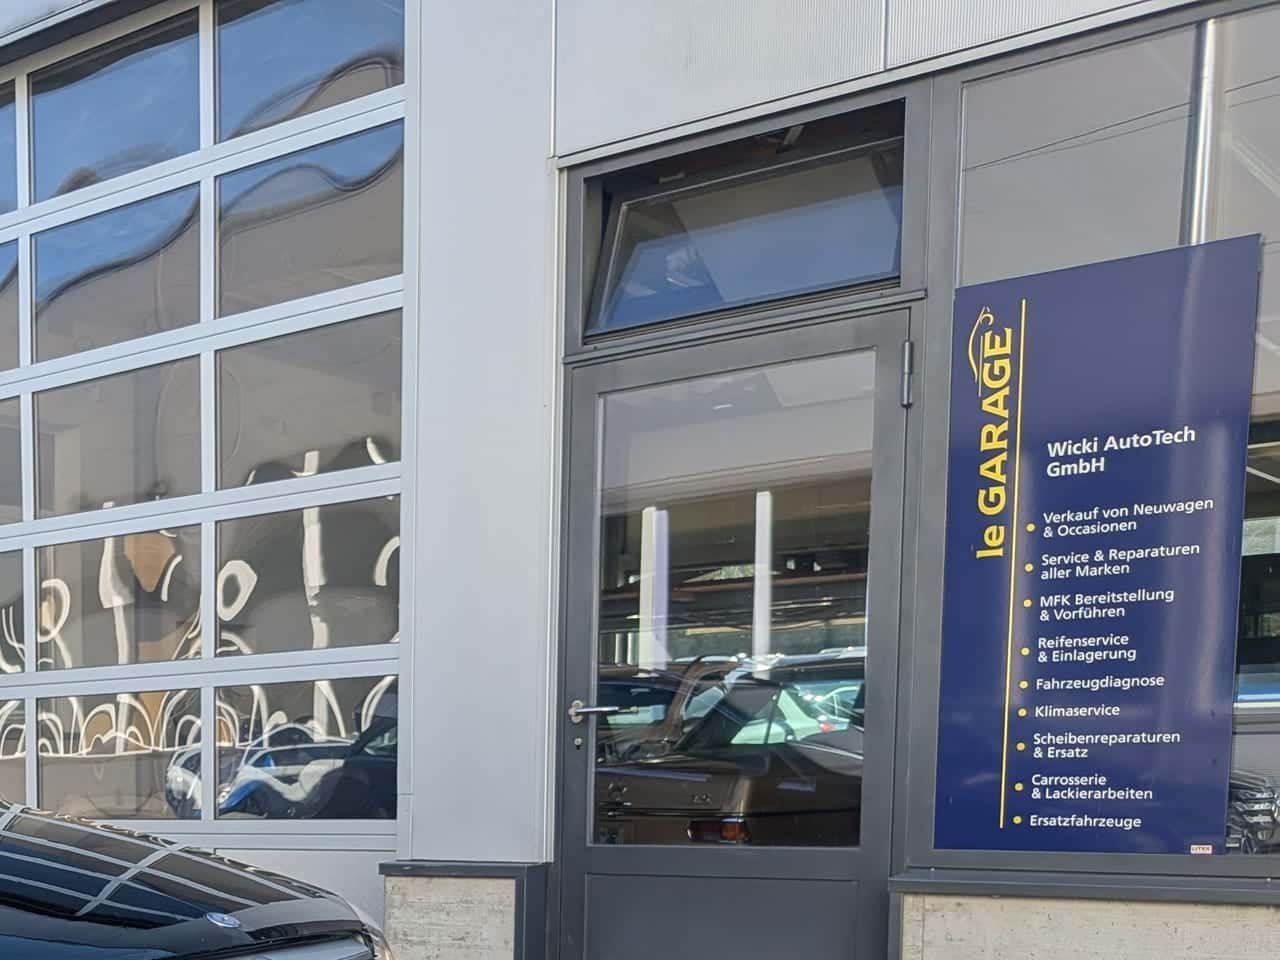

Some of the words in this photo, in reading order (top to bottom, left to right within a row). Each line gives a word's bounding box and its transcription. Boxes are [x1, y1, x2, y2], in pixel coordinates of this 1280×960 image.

[978, 328, 1012, 516] GARAGE
[1047, 437, 1099, 458] Wicki
[1104, 425, 1196, 451] AutoTech
[1046, 457, 1105, 477] GmbH
[1043, 507, 1099, 524] Verkauf
[1102, 506, 1129, 518] von
[1133, 499, 1214, 516] Neuwagen
[1043, 526, 1053, 538] &
[1057, 520, 1137, 537] Occasionen
[976, 525, 1005, 558] le
[1041, 551, 1090, 566] Service
[1094, 550, 1104, 562] &
[1109, 543, 1200, 562] Reparaturen
[1040, 567, 1072, 580] aller
[1075, 562, 1130, 577] Marken
[1040, 594, 1071, 607] MFK
[1075, 589, 1175, 605] Bereitstellung
[1040, 610, 1050, 621] &
[1054, 606, 1125, 620] Vorführen
[1038, 633, 1129, 649] Reifenservice
[1038, 651, 1048, 662] &
[1052, 649, 1137, 664] Einlagerung
[1036, 675, 1165, 691] Fahrzeugdiagnose
[1035, 704, 1120, 718] Klimaservice
[1033, 732, 1181, 746] Scheibenreparaturen
[1033, 748, 1043, 759] &
[1047, 747, 1089, 759] Ersatz
[1031, 773, 1107, 786] Carrosserie
[1031, 788, 1041, 800] &
[1045, 787, 1153, 800] Lackierarbeiten
[1030, 814, 1142, 830] Ersatzfahrzeuge
